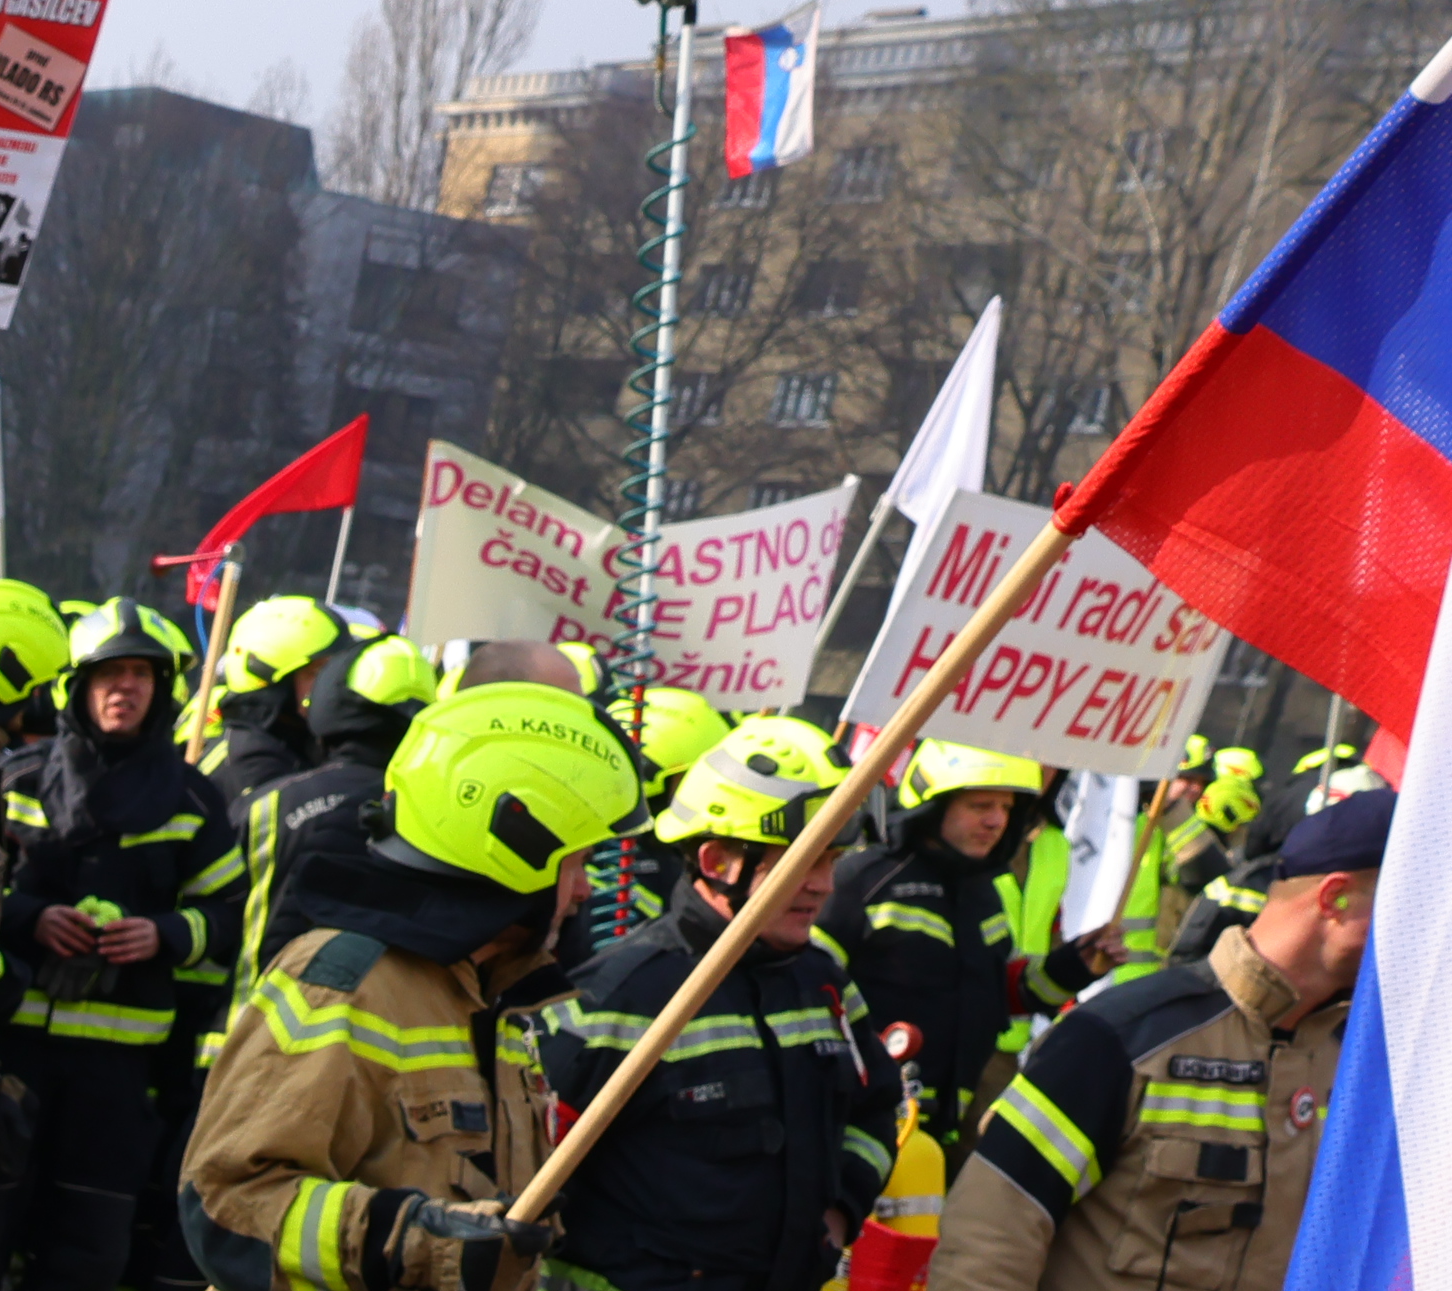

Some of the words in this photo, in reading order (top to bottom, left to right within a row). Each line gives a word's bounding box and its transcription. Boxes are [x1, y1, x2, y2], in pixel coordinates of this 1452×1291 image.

[39, 77, 66, 108] RS
[428, 458, 586, 560] Delam
[479, 528, 590, 607] čast
[925, 522, 1012, 610] Mi
[1056, 575, 1163, 647] radi
[520, 717, 622, 772] KASTELIC
[1064, 668, 1195, 750] END!
[462, 784, 477, 801] 2
